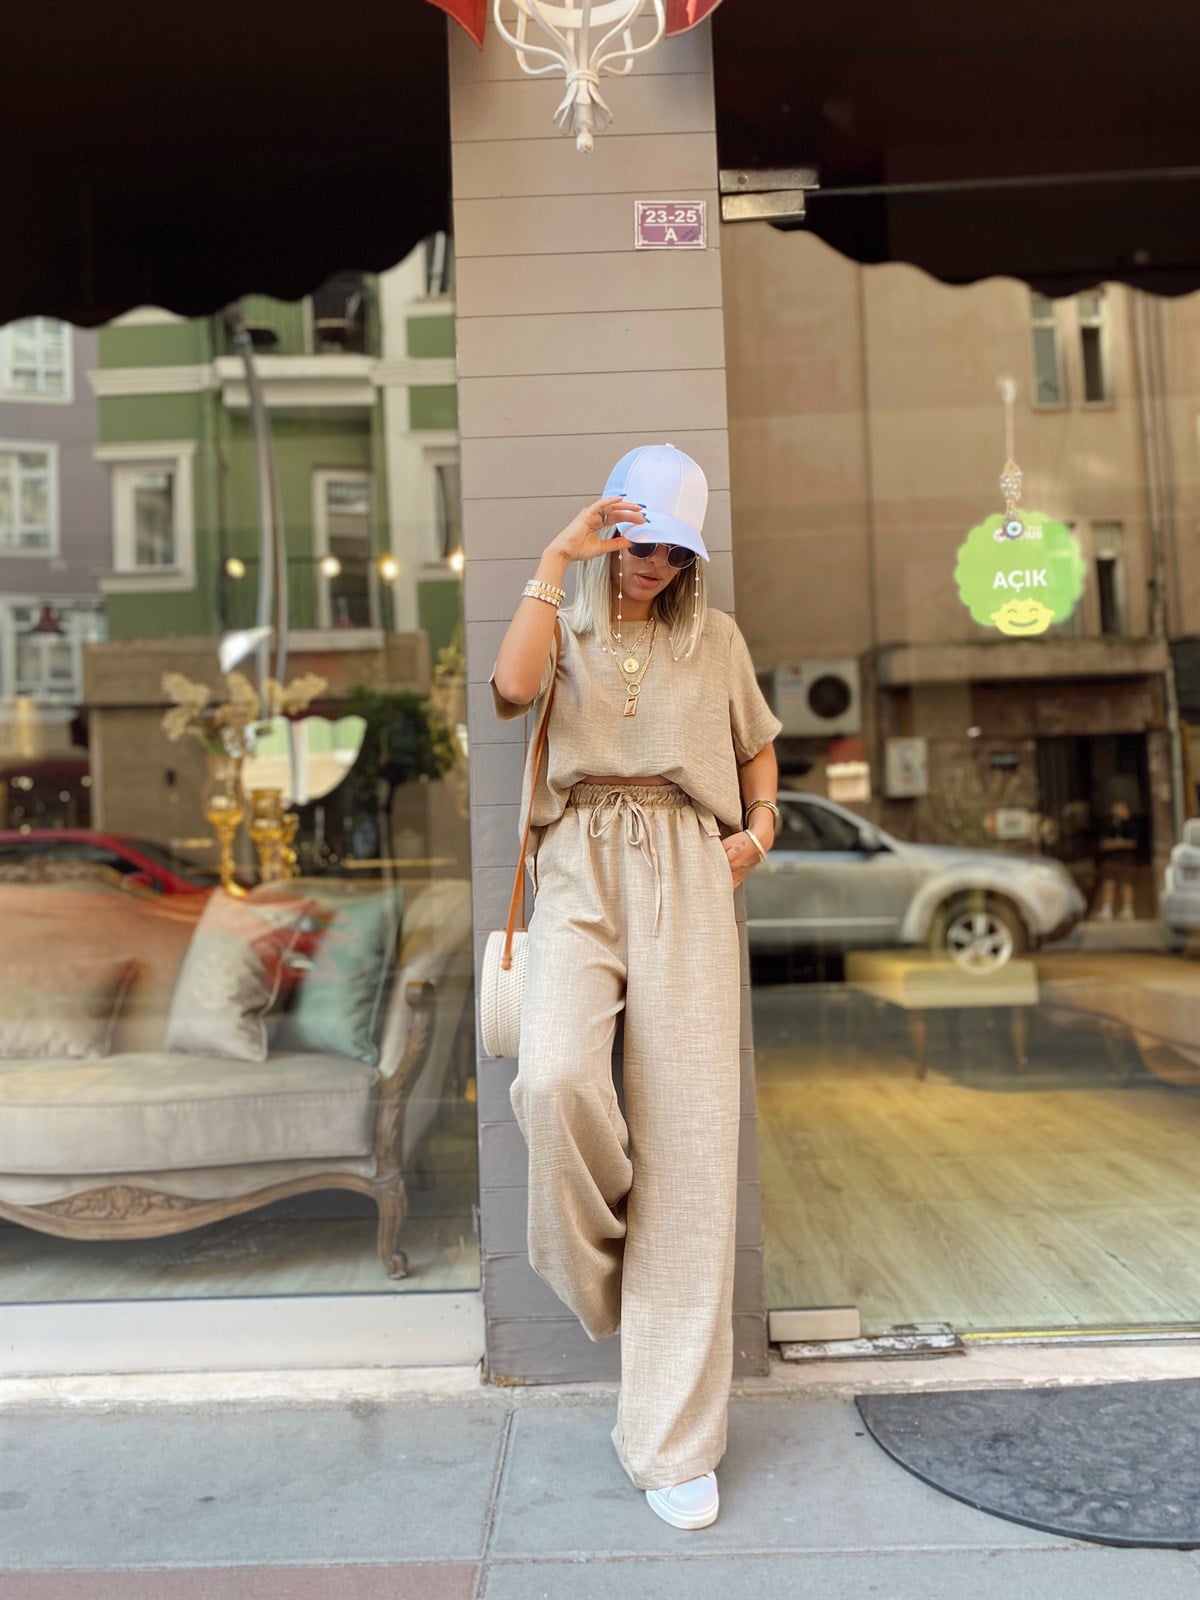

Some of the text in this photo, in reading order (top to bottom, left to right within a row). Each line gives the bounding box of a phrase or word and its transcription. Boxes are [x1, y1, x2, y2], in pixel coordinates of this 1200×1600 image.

[645, 210, 697, 223] 23-25
[664, 227, 678, 242] A
[992, 568, 1048, 592] AÇIK
